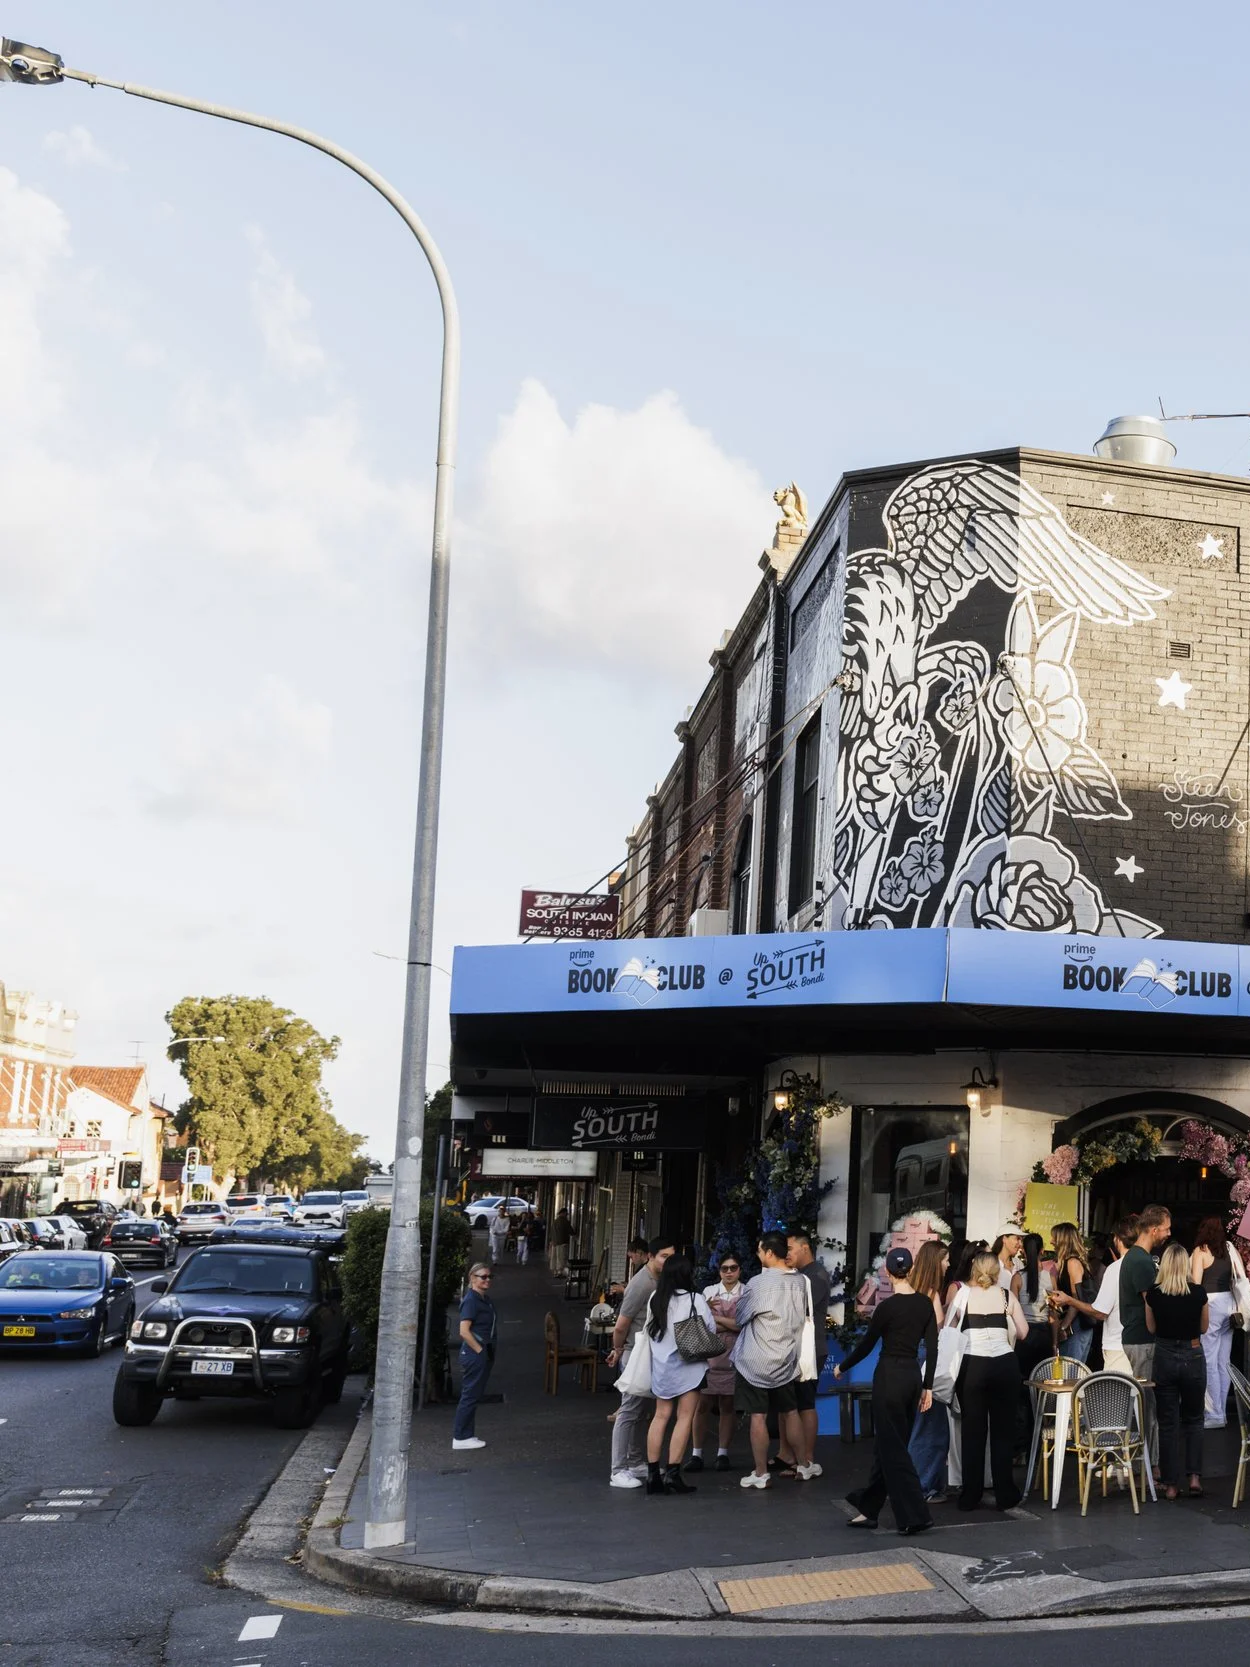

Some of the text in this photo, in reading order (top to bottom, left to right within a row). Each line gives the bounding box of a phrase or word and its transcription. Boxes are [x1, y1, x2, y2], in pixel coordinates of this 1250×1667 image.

[526, 908, 613, 922] SOUTH INDIAN
[569, 948, 595, 961] prime
[1063, 943, 1096, 956] prime
[753, 952, 769, 970] Up
[747, 948, 825, 992] SOUTH
[567, 965, 734, 993] BOOK CLUB @
[800, 972, 825, 988] Bondi
[1063, 964, 1127, 992] BOOK
[1175, 969, 1232, 998] CLUB
[581, 1105, 597, 1121] Up
[572, 1110, 658, 1141] SOUTH
[630, 1131, 657, 1142] Bondi
